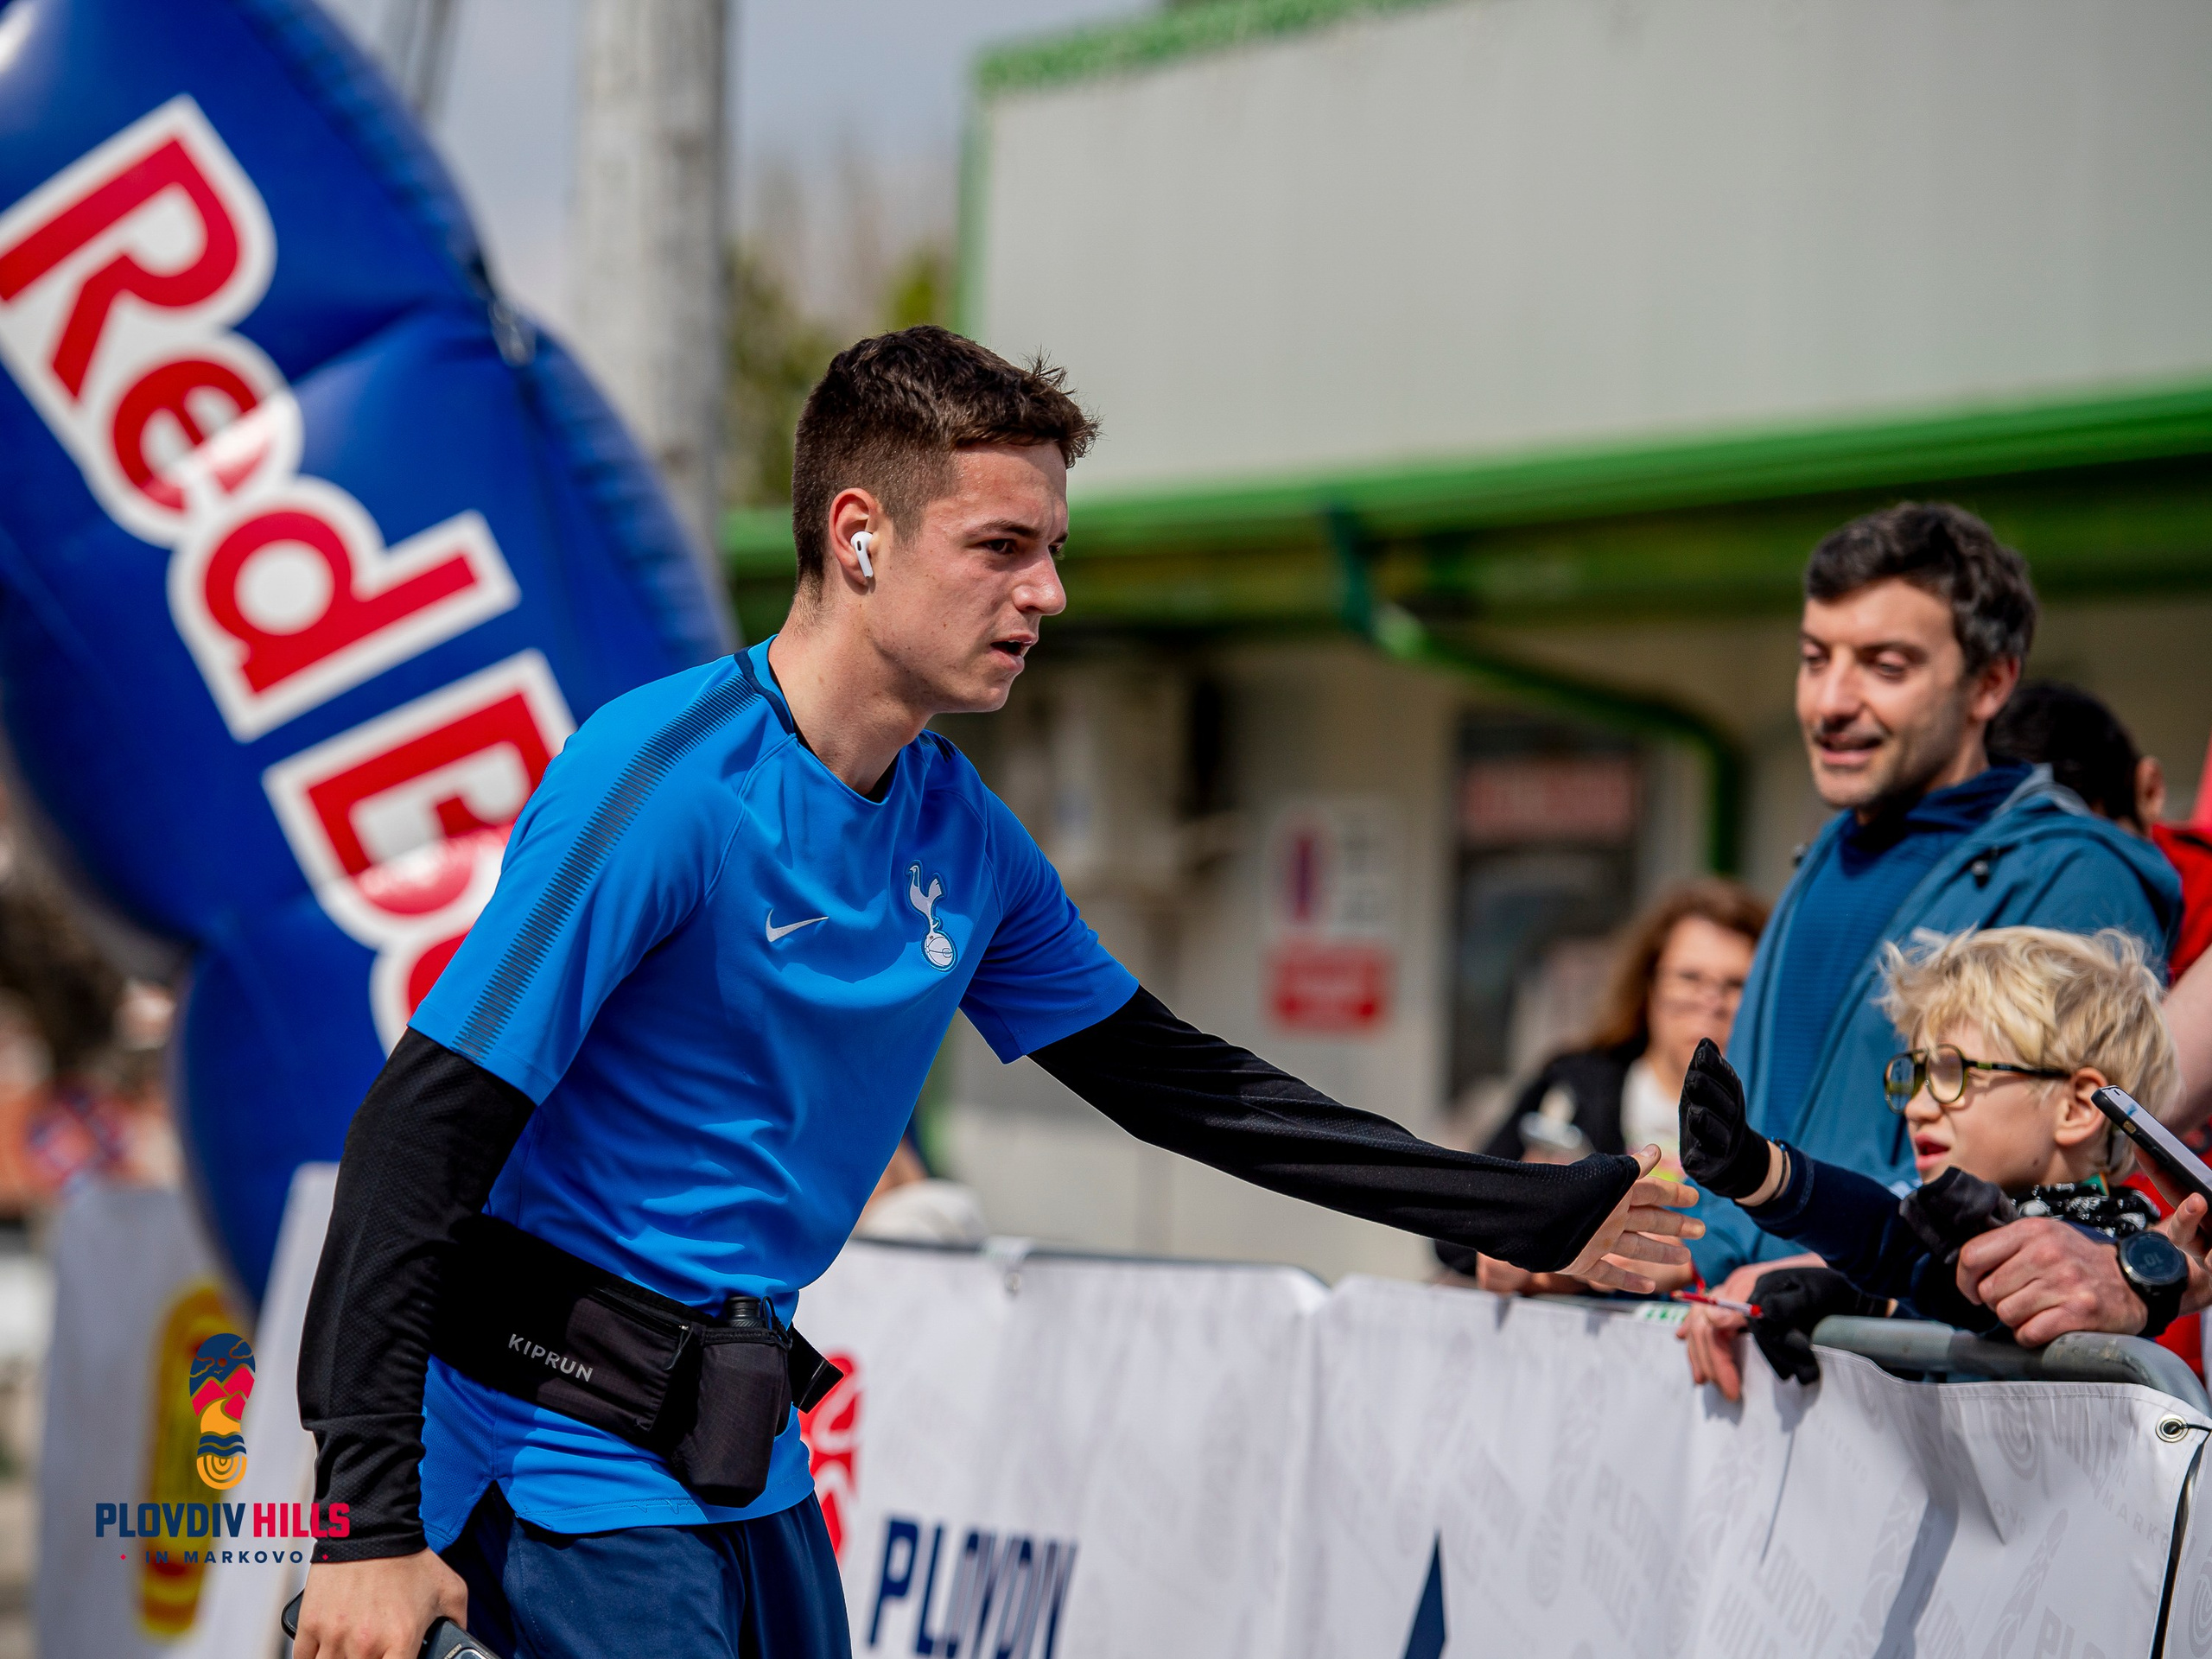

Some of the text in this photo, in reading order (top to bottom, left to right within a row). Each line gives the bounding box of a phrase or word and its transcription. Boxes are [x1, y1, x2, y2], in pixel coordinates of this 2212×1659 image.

[0, 125, 497, 713] Red
[508, 1333, 594, 1382] KIPRUN
[866, 1518, 1078, 1659] PLOVDIV
